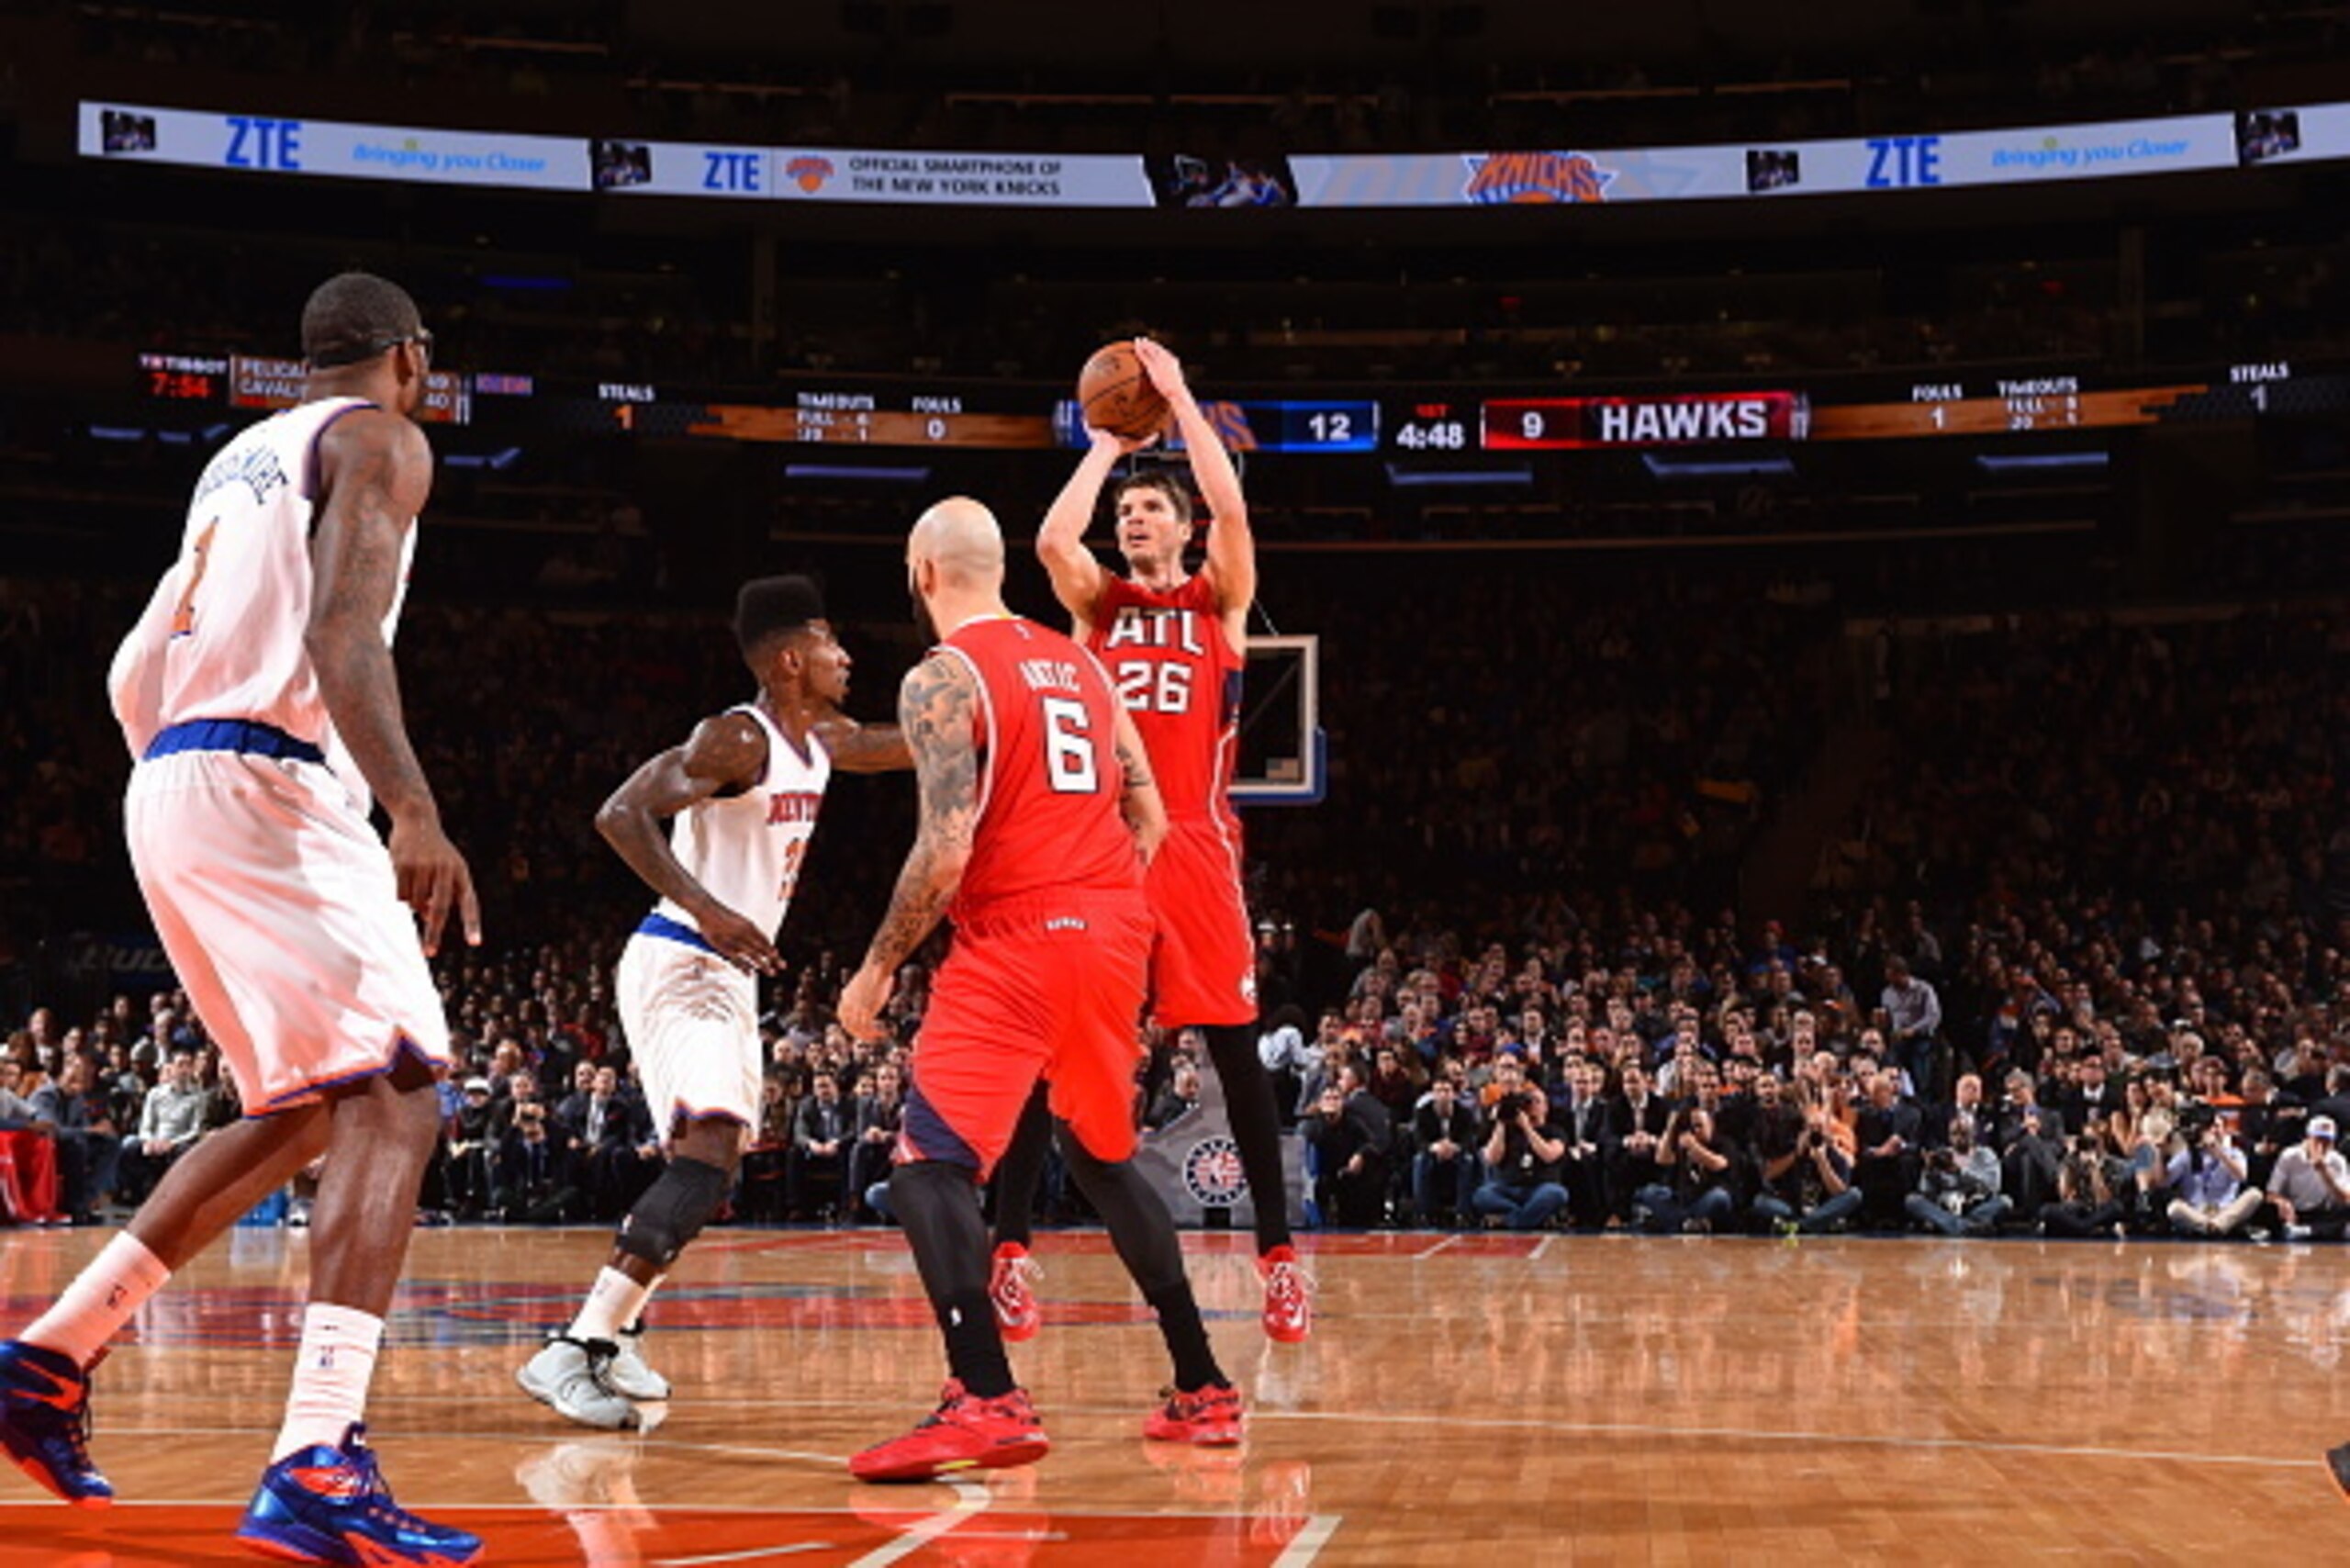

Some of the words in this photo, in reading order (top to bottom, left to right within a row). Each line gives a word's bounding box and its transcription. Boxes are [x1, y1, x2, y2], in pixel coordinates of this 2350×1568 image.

[226, 117, 301, 170] ZTE
[1992, 145, 2078, 168] Bringing
[2084, 147, 2124, 167] you
[2128, 140, 2189, 158] Closer
[353, 143, 437, 170] Bringing
[443, 153, 482, 171] you
[486, 151, 545, 172] Closer
[849, 157, 917, 172] OFFICIAL
[924, 159, 1034, 174] SMARTPHONE
[1039, 161, 1061, 174] OF
[1865, 136, 1940, 187] ZTE
[703, 151, 759, 191] ZTE
[1468, 152, 1600, 201] KNICKS
[852, 177, 882, 191] THE
[891, 178, 934, 192] NEW
[940, 179, 990, 195] YORK
[995, 179, 1060, 196] KNICKS
[2230, 361, 2289, 383] STEALS
[599, 383, 655, 401] STEALS
[1912, 384, 1963, 401] FOULS
[1997, 376, 2077, 397] TIMEOUTS
[2250, 385, 2266, 411] 1
[797, 392, 874, 409] TIMEOUTS
[912, 396, 961, 412] FOULS
[616, 405, 632, 429] 1
[927, 419, 946, 440] 0
[1310, 414, 1350, 440] 12
[1522, 411, 1544, 439] 9
[1602, 400, 1766, 442] HAWKS
[1932, 407, 1944, 429] 1
[1396, 421, 1465, 450] 4:48
[1106, 605, 1204, 655] ATL
[1117, 660, 1192, 713] 26
[1042, 695, 1100, 793] 6
